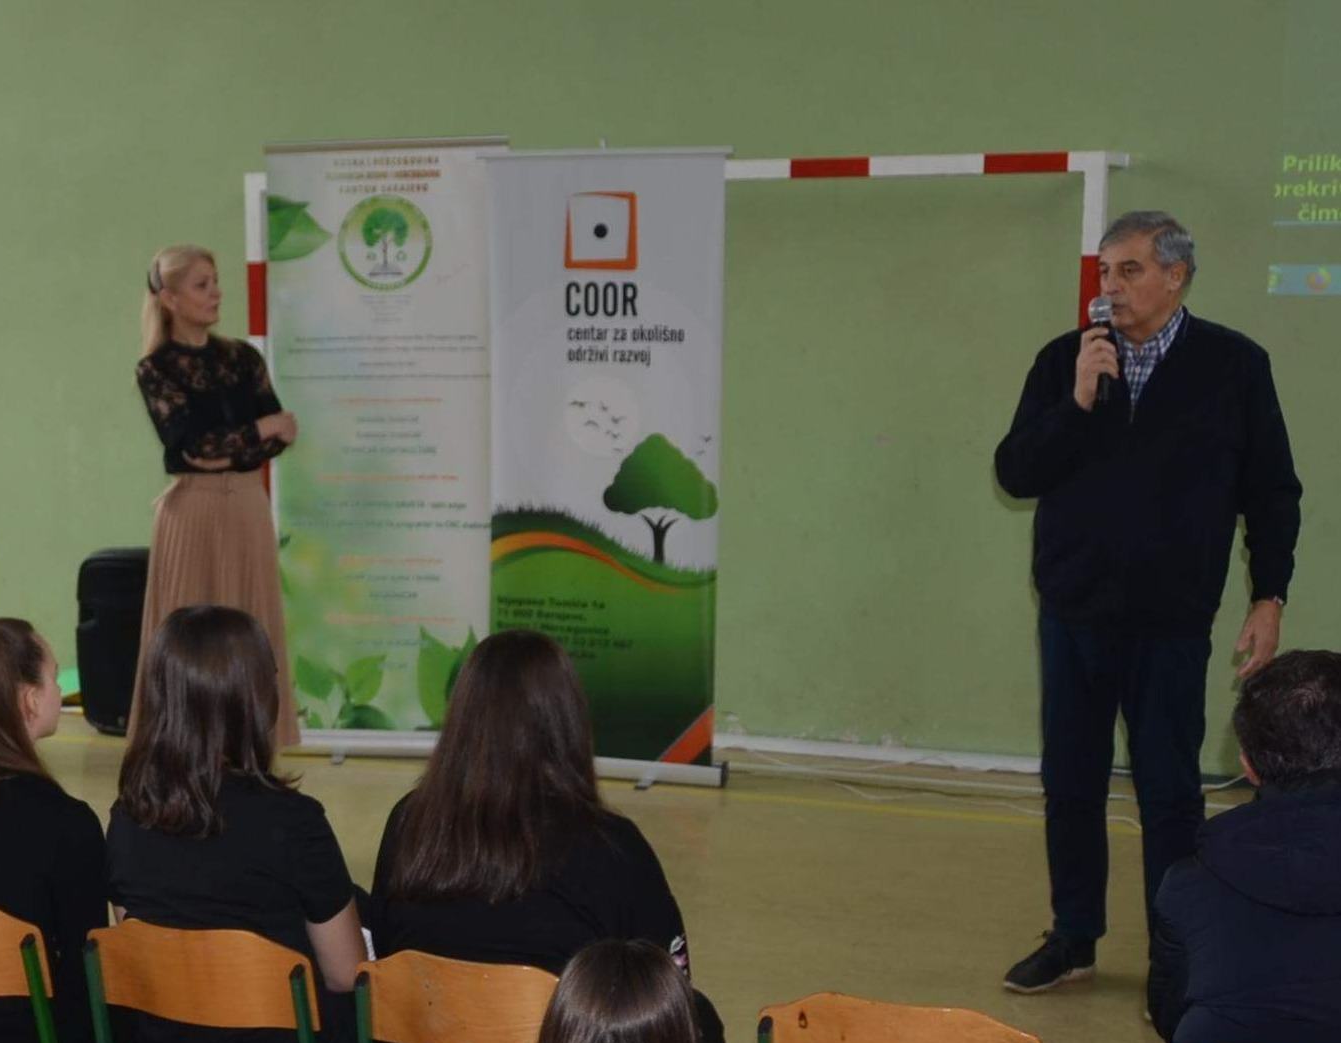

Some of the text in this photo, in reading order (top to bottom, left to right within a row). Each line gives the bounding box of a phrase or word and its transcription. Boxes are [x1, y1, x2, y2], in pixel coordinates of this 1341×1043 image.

[1274, 179, 1341, 197] rekri
[1298, 202, 1341, 221] čim
[565, 281, 638, 317] COOR
[567, 325, 685, 343] centar za okolišno
[567, 345, 651, 367] održivi razvoj
